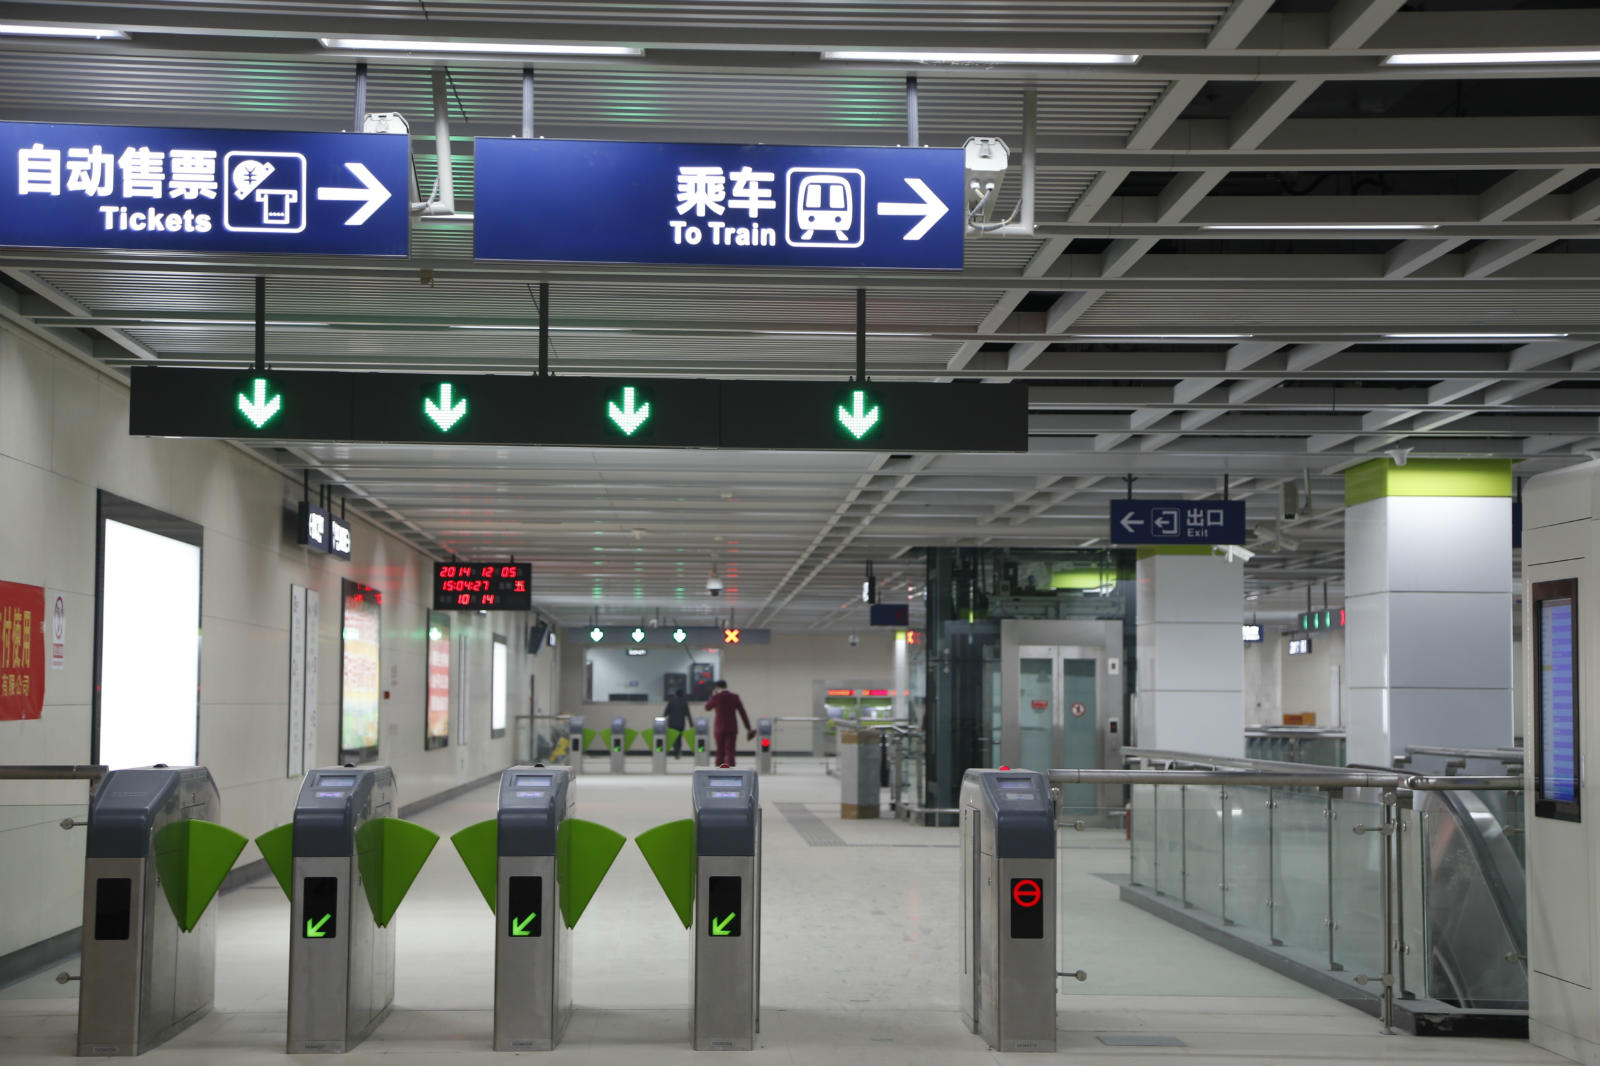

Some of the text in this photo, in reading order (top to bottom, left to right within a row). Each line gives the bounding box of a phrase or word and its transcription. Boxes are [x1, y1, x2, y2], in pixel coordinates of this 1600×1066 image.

[17, 143, 218, 200] 自动售票
[676, 166, 776, 218] 乘车
[99, 205, 212, 234] Tickets
[669, 220, 776, 247] To Train
[1186, 508, 1224, 527] 出口
[1187, 528, 1208, 537] Exit
[481, 566, 495, 578] 12
[500, 566, 517, 578] 05
[442, 580, 490, 592] 15:04:27
[457, 593, 495, 605] 10 14
